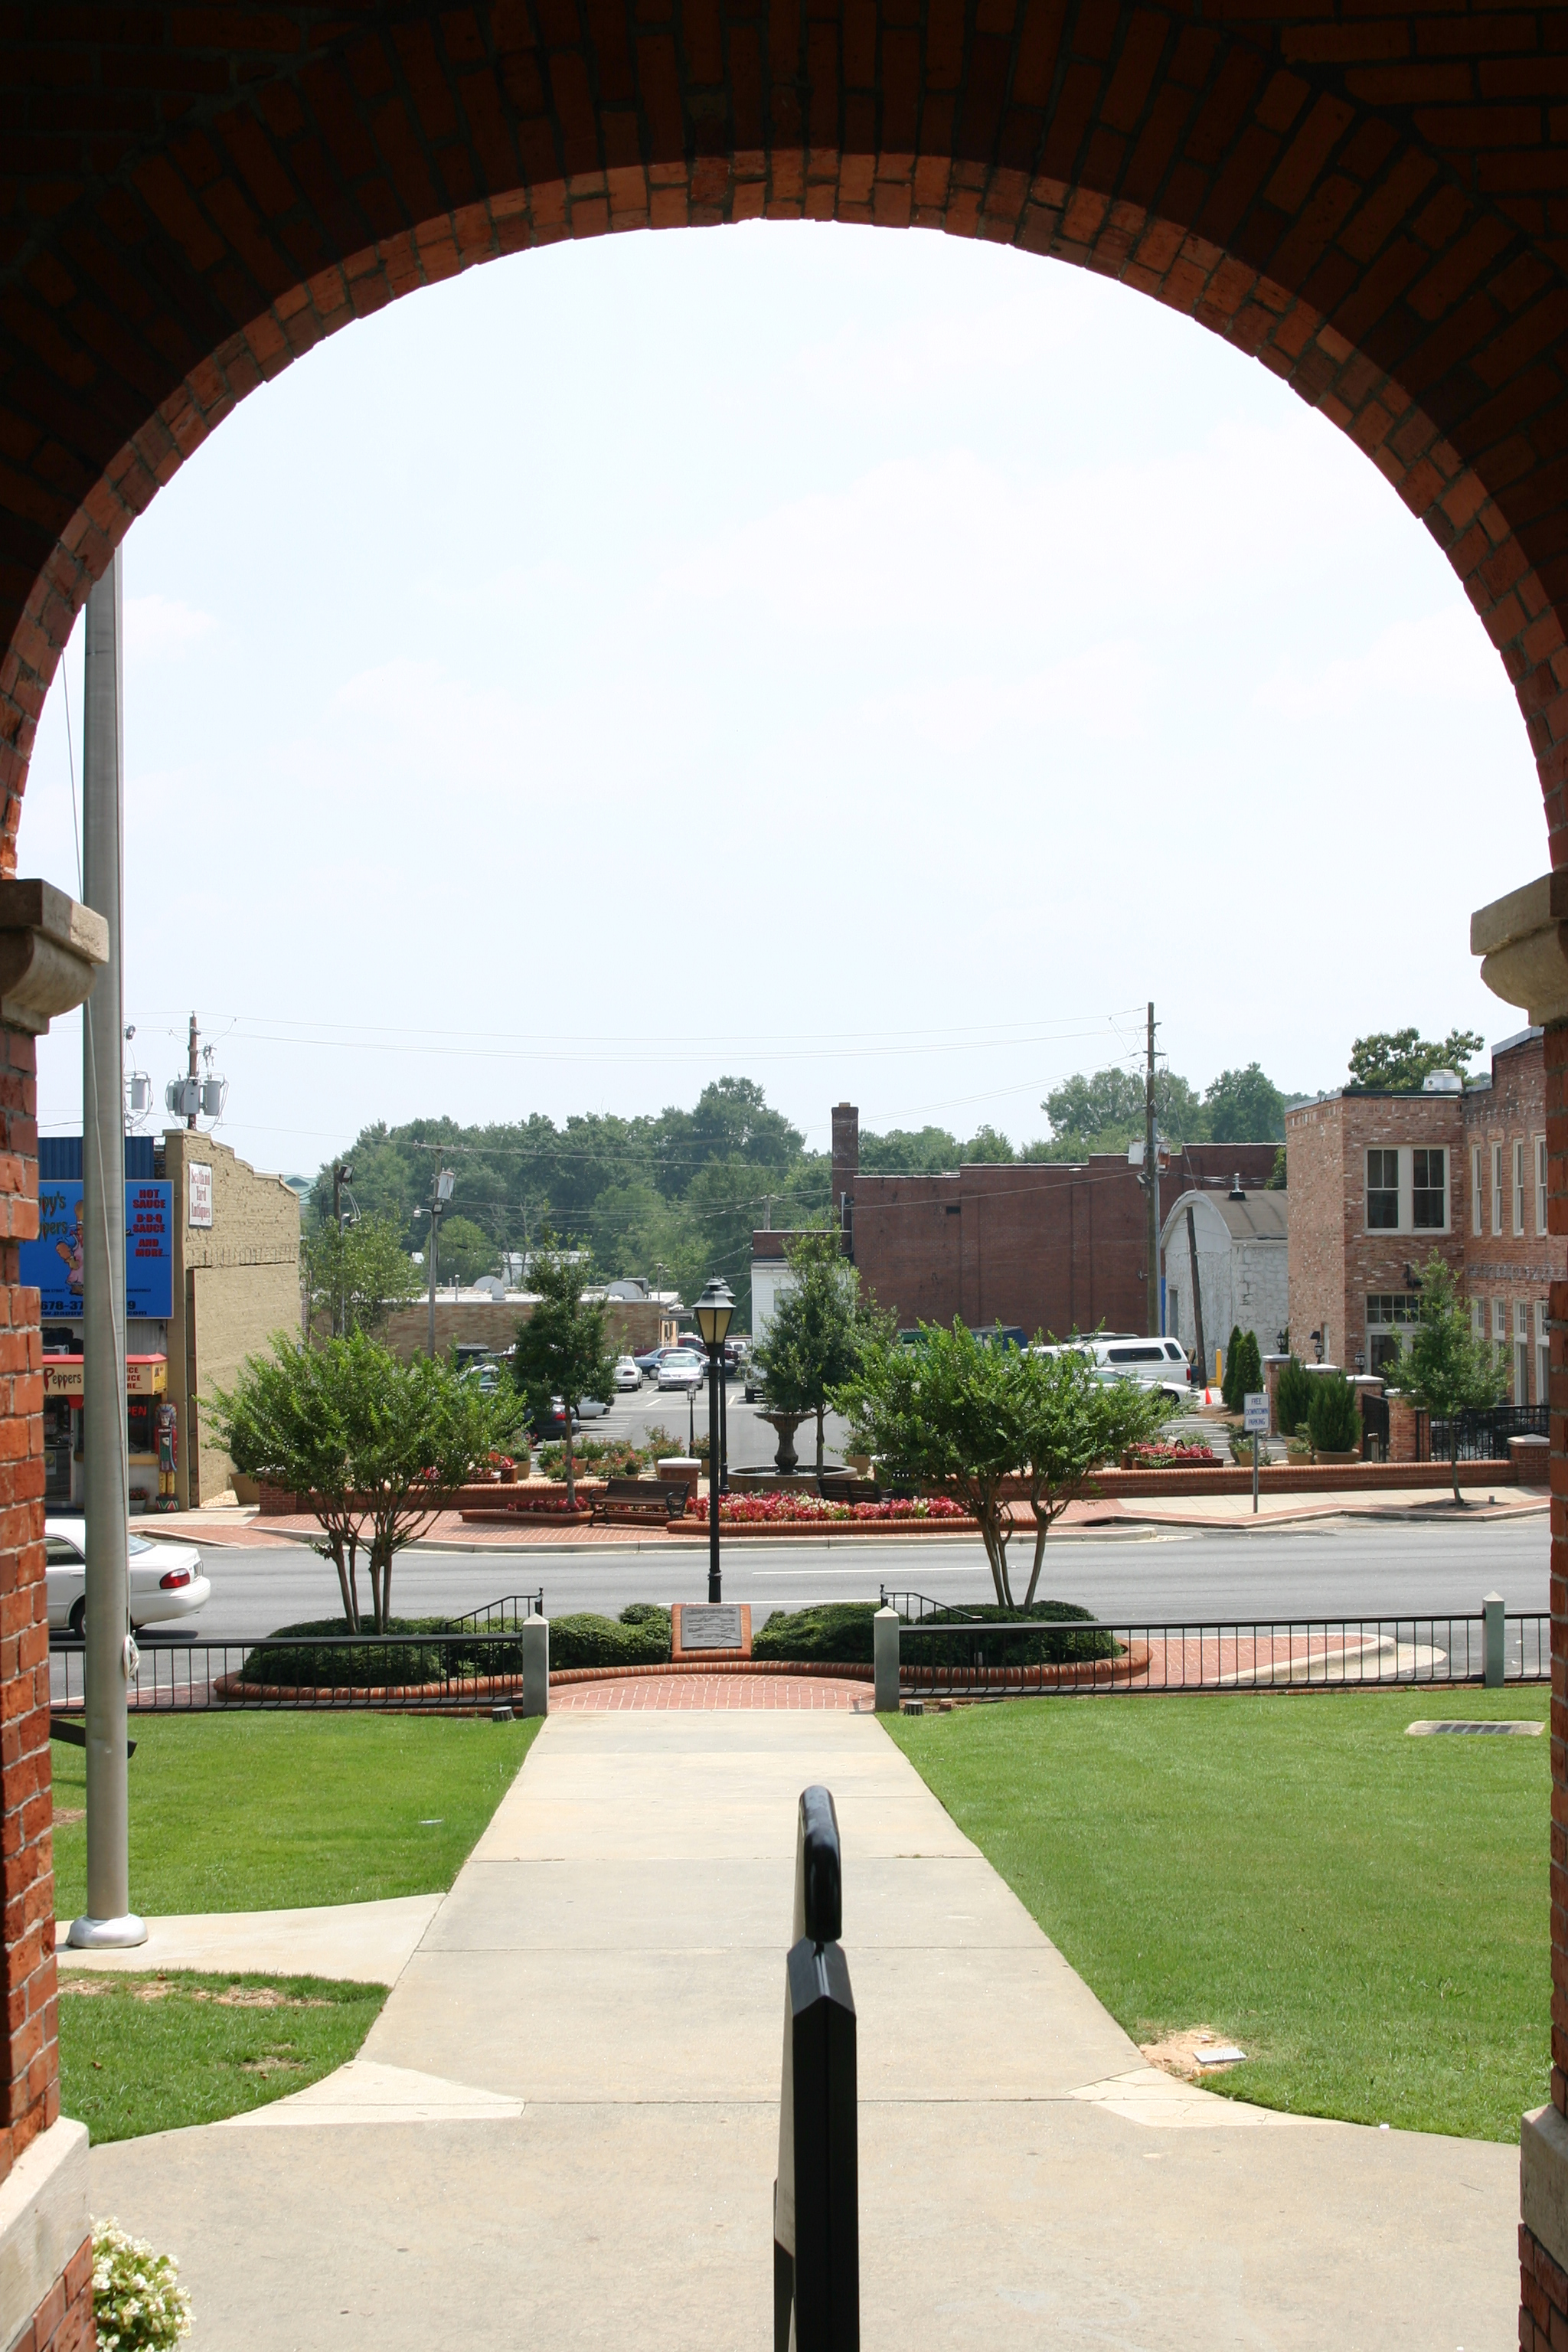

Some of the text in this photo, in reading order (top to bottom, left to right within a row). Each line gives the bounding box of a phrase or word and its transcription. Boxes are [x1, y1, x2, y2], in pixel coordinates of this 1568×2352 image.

[139, 1189, 160, 1198] HOT
[196, 1186, 207, 1201] Yard
[132, 1199, 166, 1208] SAUCE
[132, 1223, 165, 1233] SAUCE
[139, 1238, 158, 1247] AND
[44, 1367, 82, 1393] Peppers
